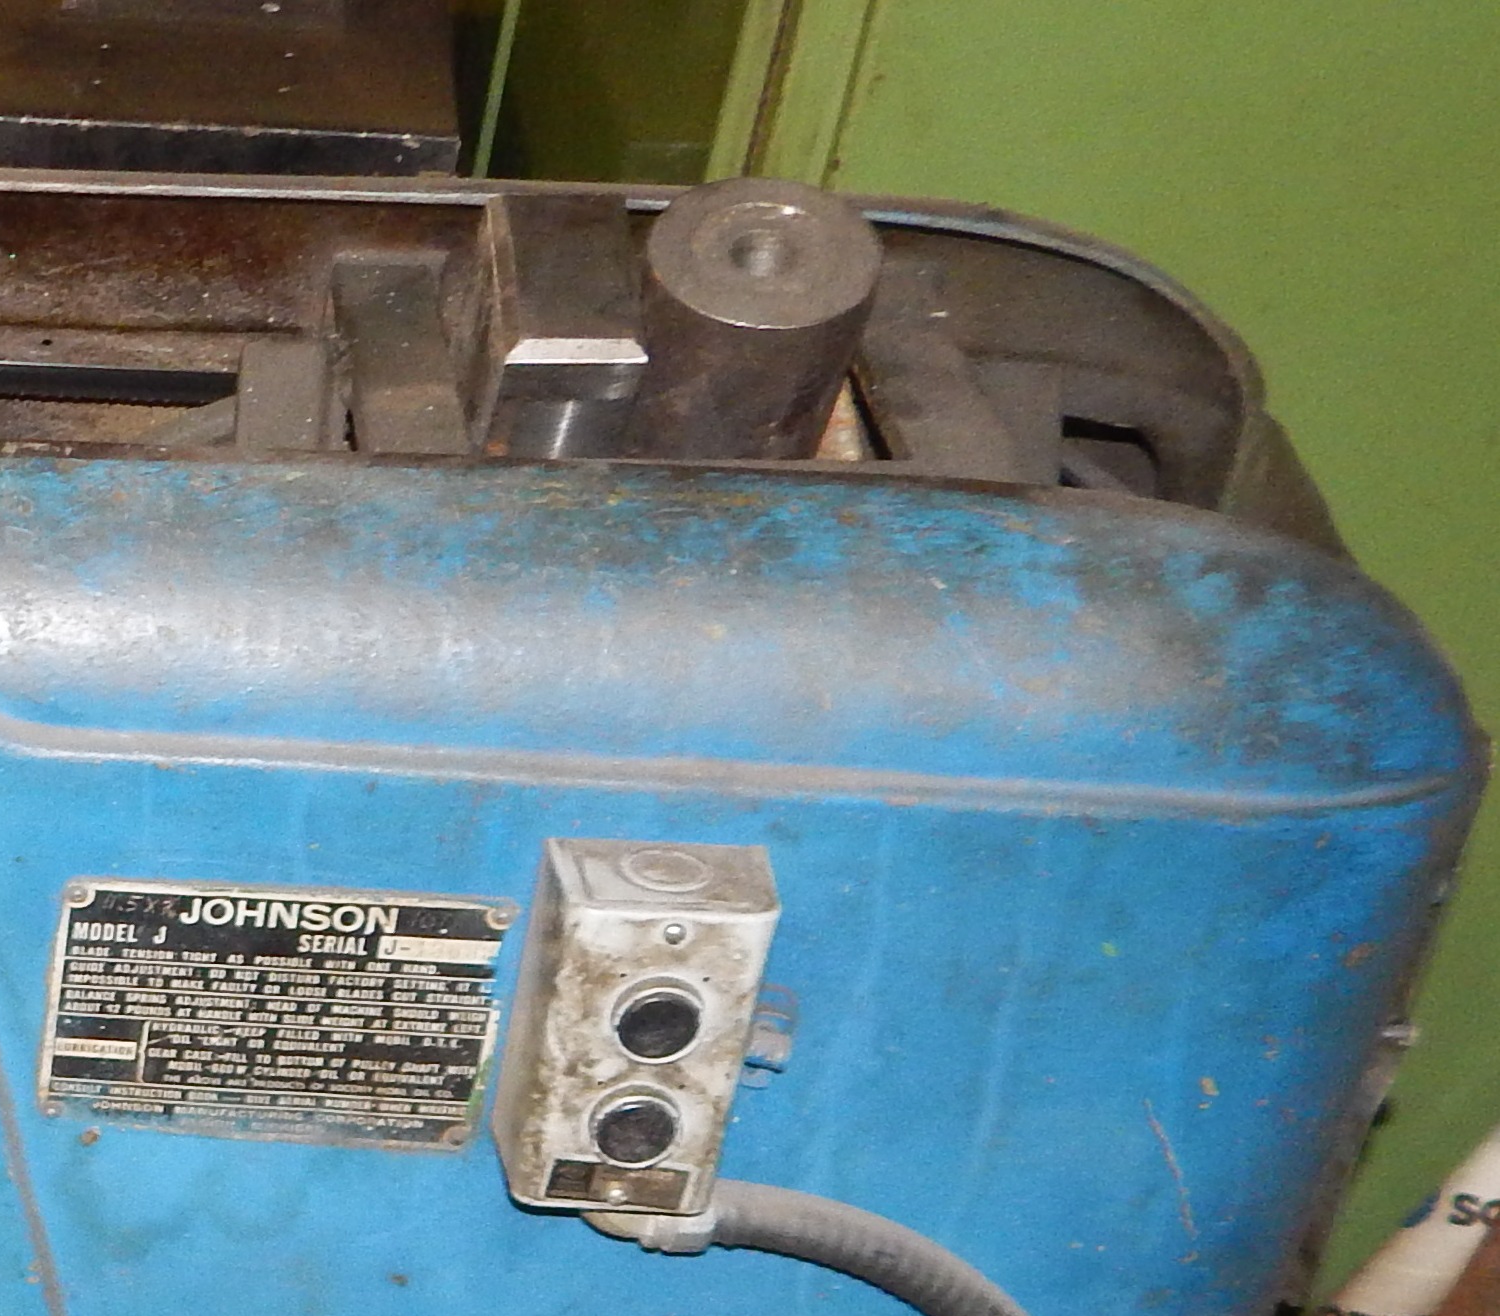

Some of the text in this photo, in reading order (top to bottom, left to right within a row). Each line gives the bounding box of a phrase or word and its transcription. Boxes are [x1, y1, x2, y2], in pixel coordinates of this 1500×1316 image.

[179, 898, 400, 936] JOHNSON
[70, 921, 139, 943] MODEL
[152, 925, 168, 945] J
[296, 933, 368, 956] SERIAL
[72, 946, 110, 956] BLADE
[183, 953, 216, 963] TIGHT
[228, 954, 244, 964] AS
[255, 956, 312, 968] POSSIBLE
[325, 961, 356, 971] WITH
[70, 961, 104, 972] GUIDE
[270, 973, 320, 985] DISTURB
[329, 977, 385, 987] FACTORY
[68, 973, 138, 985] IMPOSSIBLE
[148, 978, 164, 987] TO
[171, 980, 204, 990] MAKE
[212, 981, 257, 992] FAULTY
[264, 985, 280, 994] OR
[289, 986, 327, 997] LOOSE
[337, 989, 384, 999] BLADES
[392, 991, 417, 1001] CUT
[65, 1001, 101, 1012] ABOUT
[126, 1005, 171, 1017] POUNDS
[177, 1009, 191, 1018] AT
[198, 1010, 242, 1020] HANDLE
[283, 1014, 314, 1025] SLIDE
[67, 989, 115, 1000] BALANCE
[127, 993, 167, 1004] SPRING
[267, 1002, 297, 1012] HEAD
[307, 1004, 322, 1013] OF
[331, 1006, 383, 1015] MACHINE
[394, 1008, 439, 1019] SHOULD
[248, 1039, 265, 1049] OR
[274, 1041, 345, 1054] EQUIVALENT
[278, 1030, 319, 1040] FILLED
[149, 1048, 177, 1058] GEAR
[256, 1054, 271, 1064] TO
[278, 1056, 324, 1068] BOTTOM
[254, 1067, 311, 1078] CYLINDER
[348, 1071, 366, 1080] OR
[373, 1072, 444, 1086] EQUIVALENT
[110, 1086, 182, 1099] INSTRUCTION
[92, 1099, 164, 1113] JOHNSON
[173, 1104, 303, 1122] MANUFACTURING
[316, 1113, 423, 1129] CORPORATION
